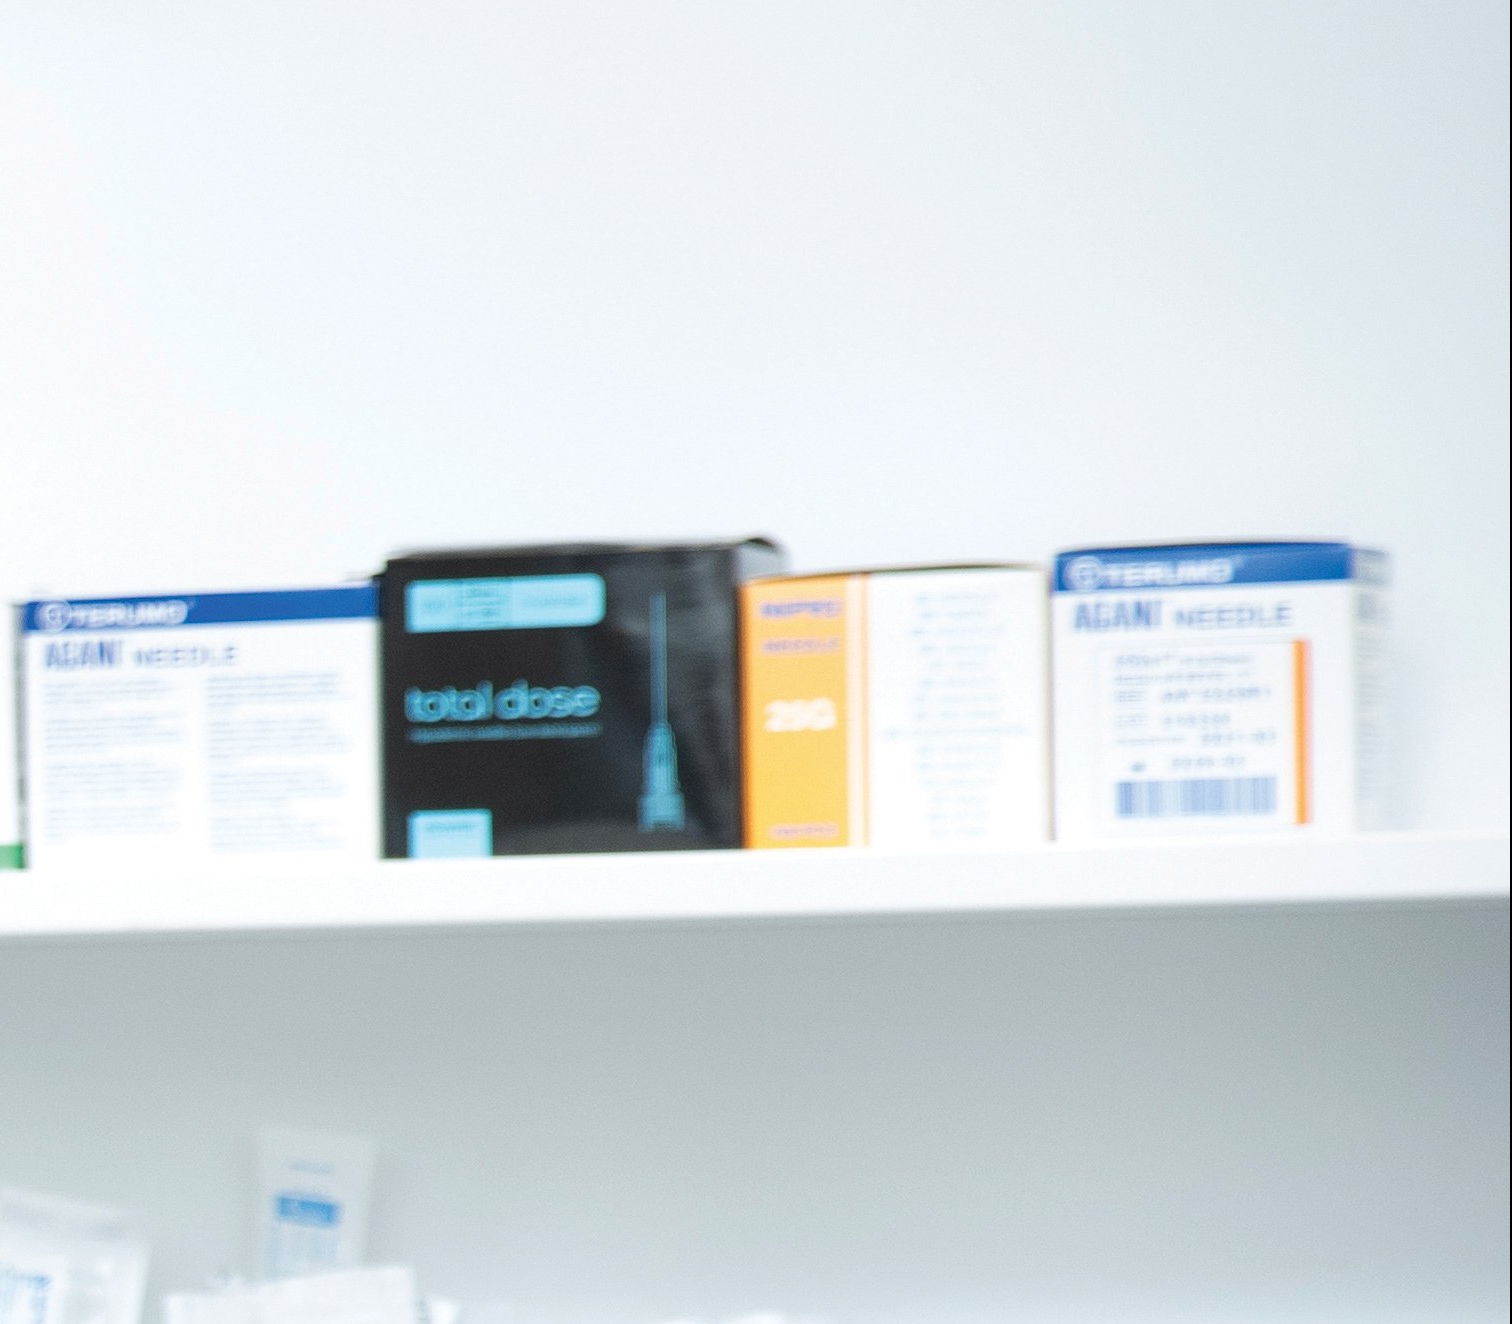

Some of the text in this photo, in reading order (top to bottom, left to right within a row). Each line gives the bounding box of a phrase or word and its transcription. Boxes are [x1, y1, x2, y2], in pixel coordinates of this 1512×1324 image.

[1103, 560, 1234, 587] TERUMO
[1172, 604, 1295, 630] NEEDLE
[132, 643, 241, 669] NEEDLE
[404, 677, 602, 722] total dose
